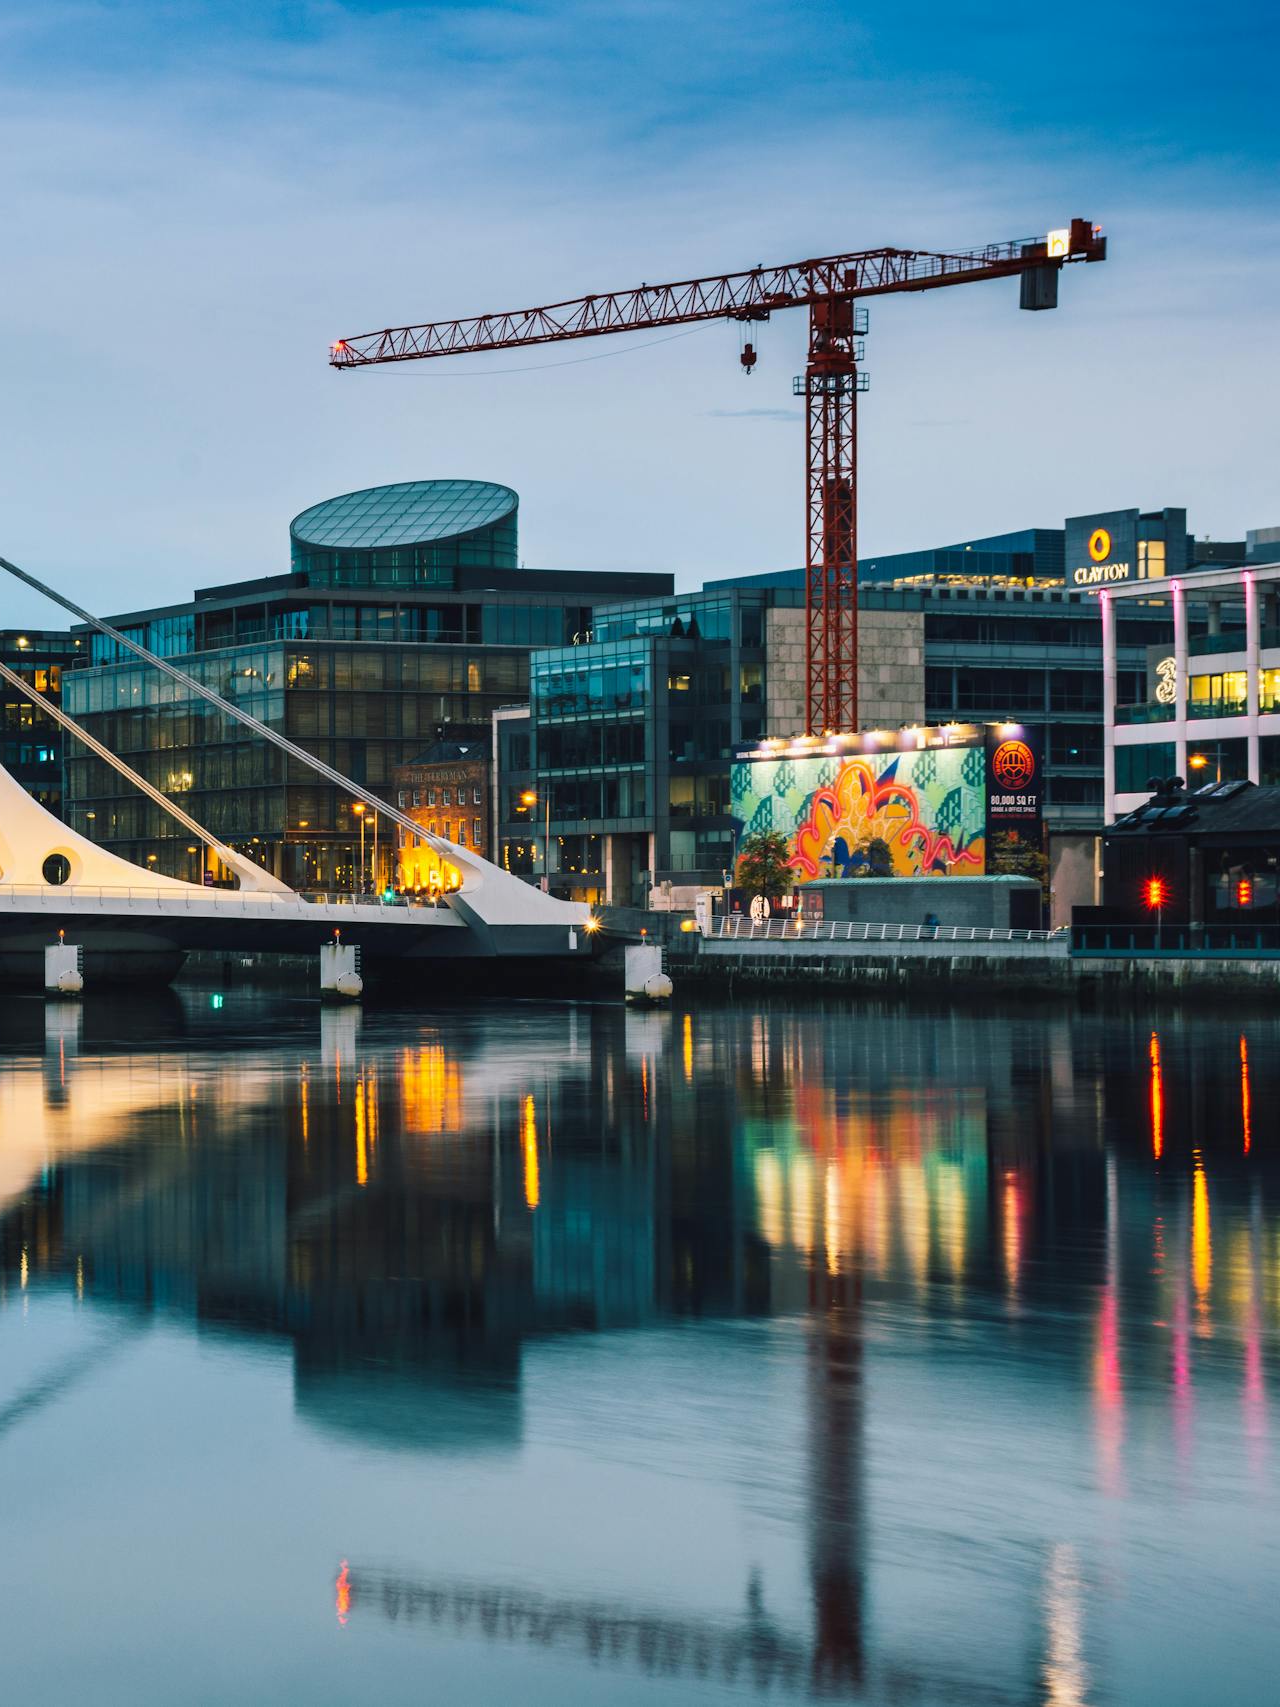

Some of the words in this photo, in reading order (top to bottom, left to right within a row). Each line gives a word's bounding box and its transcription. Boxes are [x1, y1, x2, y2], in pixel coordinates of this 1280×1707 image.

[1074, 563, 1129, 584] CLAYTON
[1016, 795, 1026, 805] SQ
[1028, 796, 1036, 805] FT
